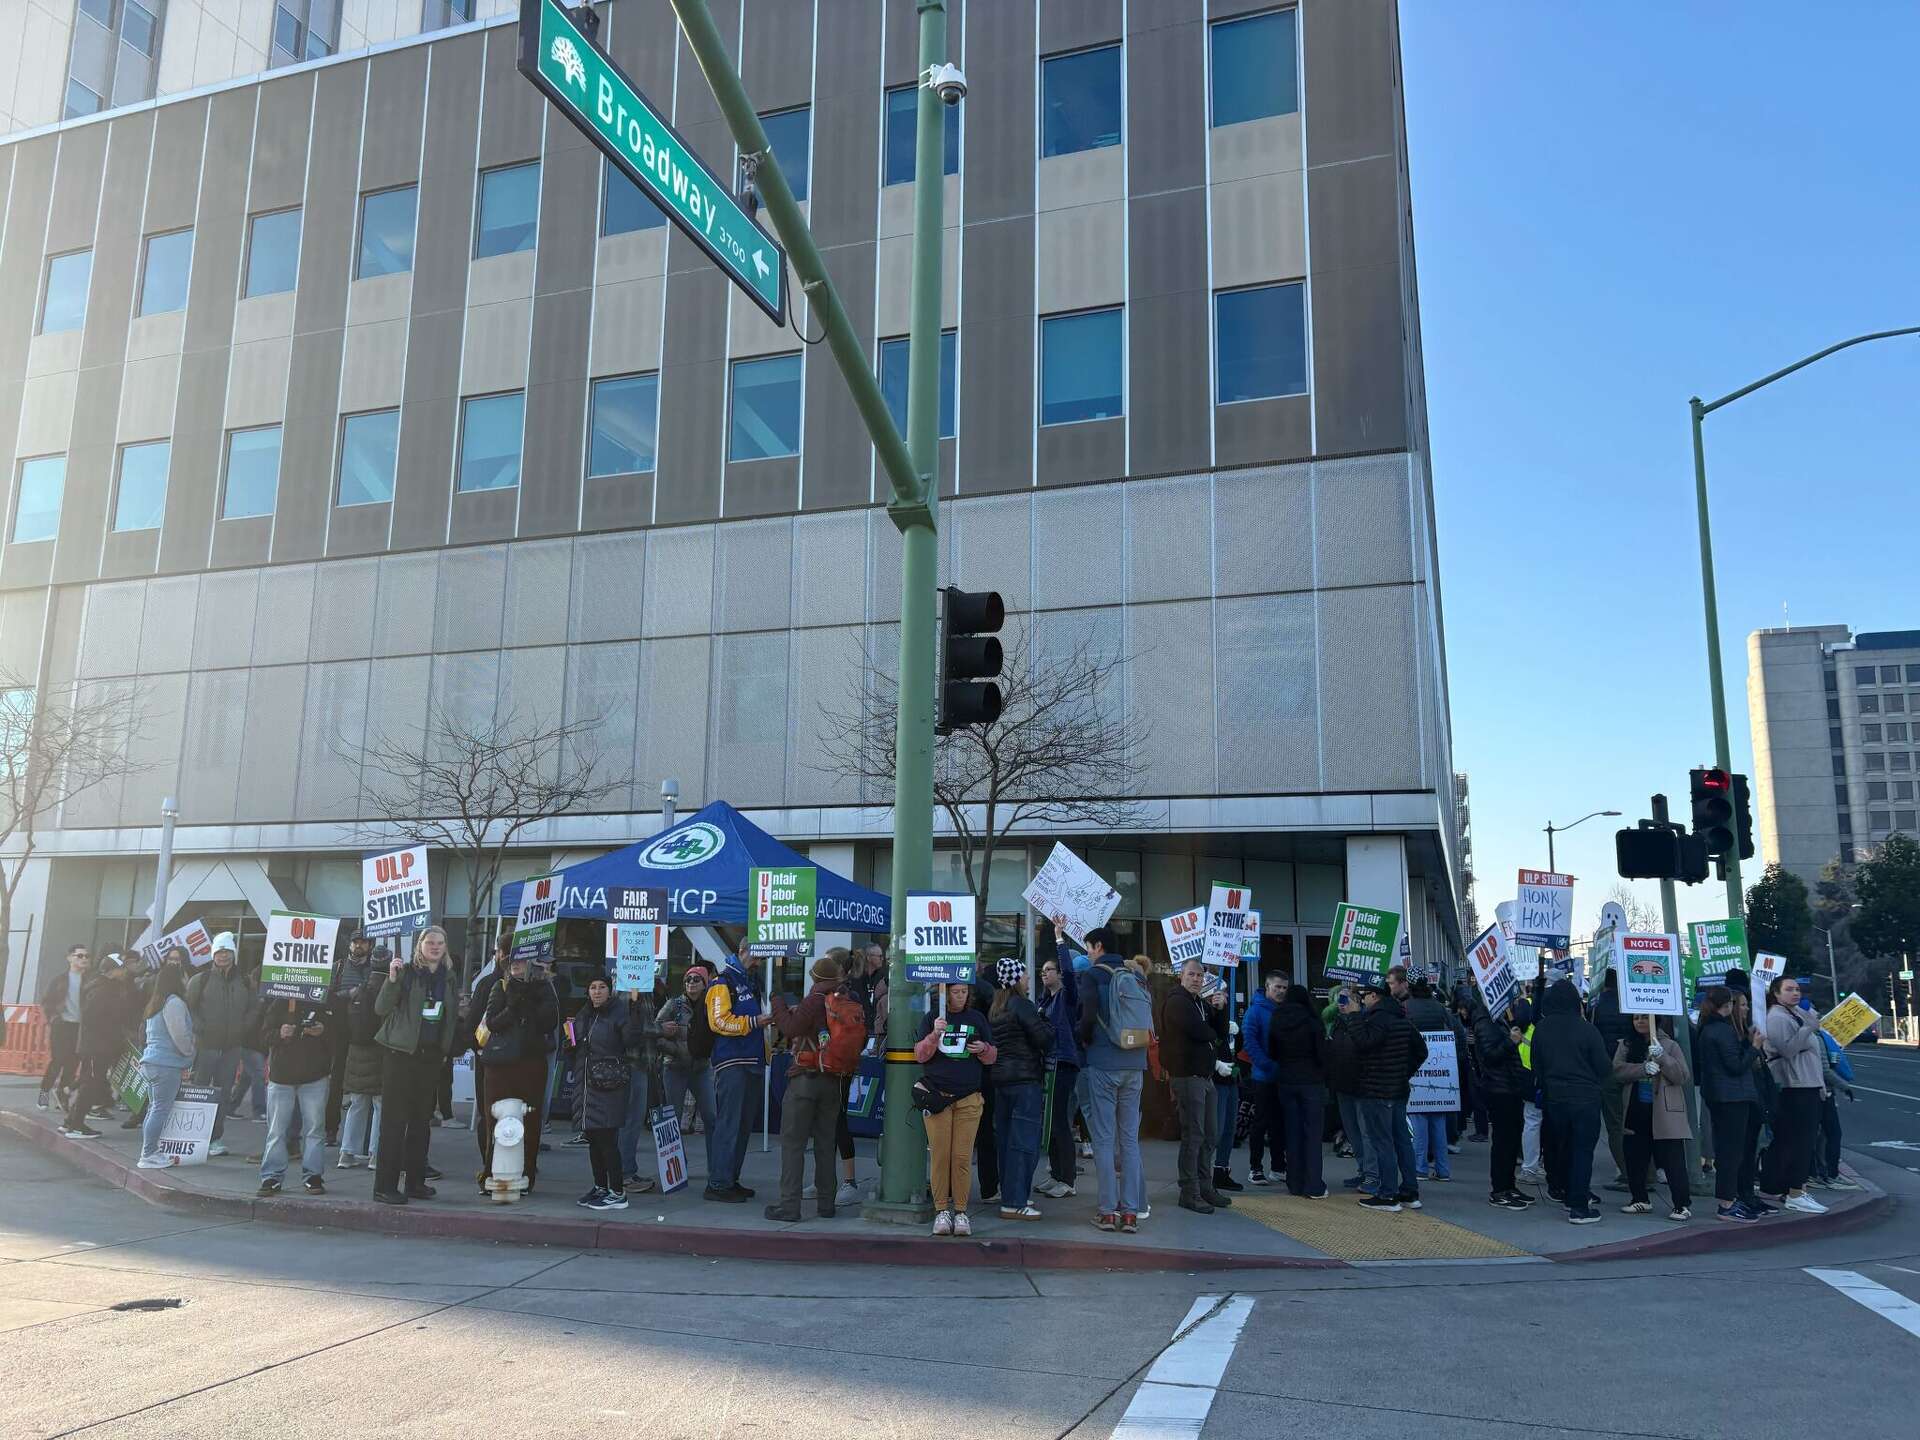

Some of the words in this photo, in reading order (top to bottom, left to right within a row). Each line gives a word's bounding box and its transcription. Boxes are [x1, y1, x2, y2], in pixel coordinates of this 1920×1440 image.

[597, 73, 716, 234] Broadway
[719, 227, 746, 264] 3700
[376, 852, 415, 883] ULP
[761, 872, 797, 887] Unfair
[1524, 872, 1540, 884] ULP
[1542, 873, 1569, 886] STRIKE
[536, 879, 551, 900] ON
[623, 890, 648, 906] FAIR
[761, 888, 797, 902] Labor
[1227, 889, 1241, 909] ON
[1524, 888, 1560, 908] HONK
[367, 888, 426, 920] STRIKE
[523, 900, 557, 925] STRIKE
[613, 907, 659, 920] CONTRACT
[760, 903, 809, 918] Practice
[928, 901, 952, 923] ON
[1171, 912, 1198, 935] ULP
[1213, 912, 1245, 930] STRIKE
[1347, 910, 1381, 925] Unfair
[1522, 907, 1563, 930] HONK
[291, 918, 316, 940] ON
[758, 922, 806, 941] STRIKE
[914, 926, 968, 946] STRIKE
[1344, 923, 1379, 938] Labor
[1697, 923, 1727, 936] Unfair
[186, 929, 211, 957] ULP
[1170, 936, 1206, 961] STRIK
[1341, 936, 1387, 954] Practice
[1630, 940, 1664, 949] NOTICE
[1700, 935, 1729, 947] Labor
[273, 942, 329, 964] STRIKE
[1475, 935, 1498, 970] ULP
[1701, 945, 1742, 959] Practice
[1336, 953, 1381, 972] STRIKE
[271, 973, 283, 981] Our
[285, 973, 323, 983] Professions
[1484, 963, 1515, 1005] STRIKE
[1635, 996, 1664, 1005] thriving
[1424, 1069, 1450, 1077] PRISONS
[655, 1120, 679, 1148] STRIKE
[160, 1141, 195, 1155] STRIKE
[666, 1156, 683, 1185] ULP
